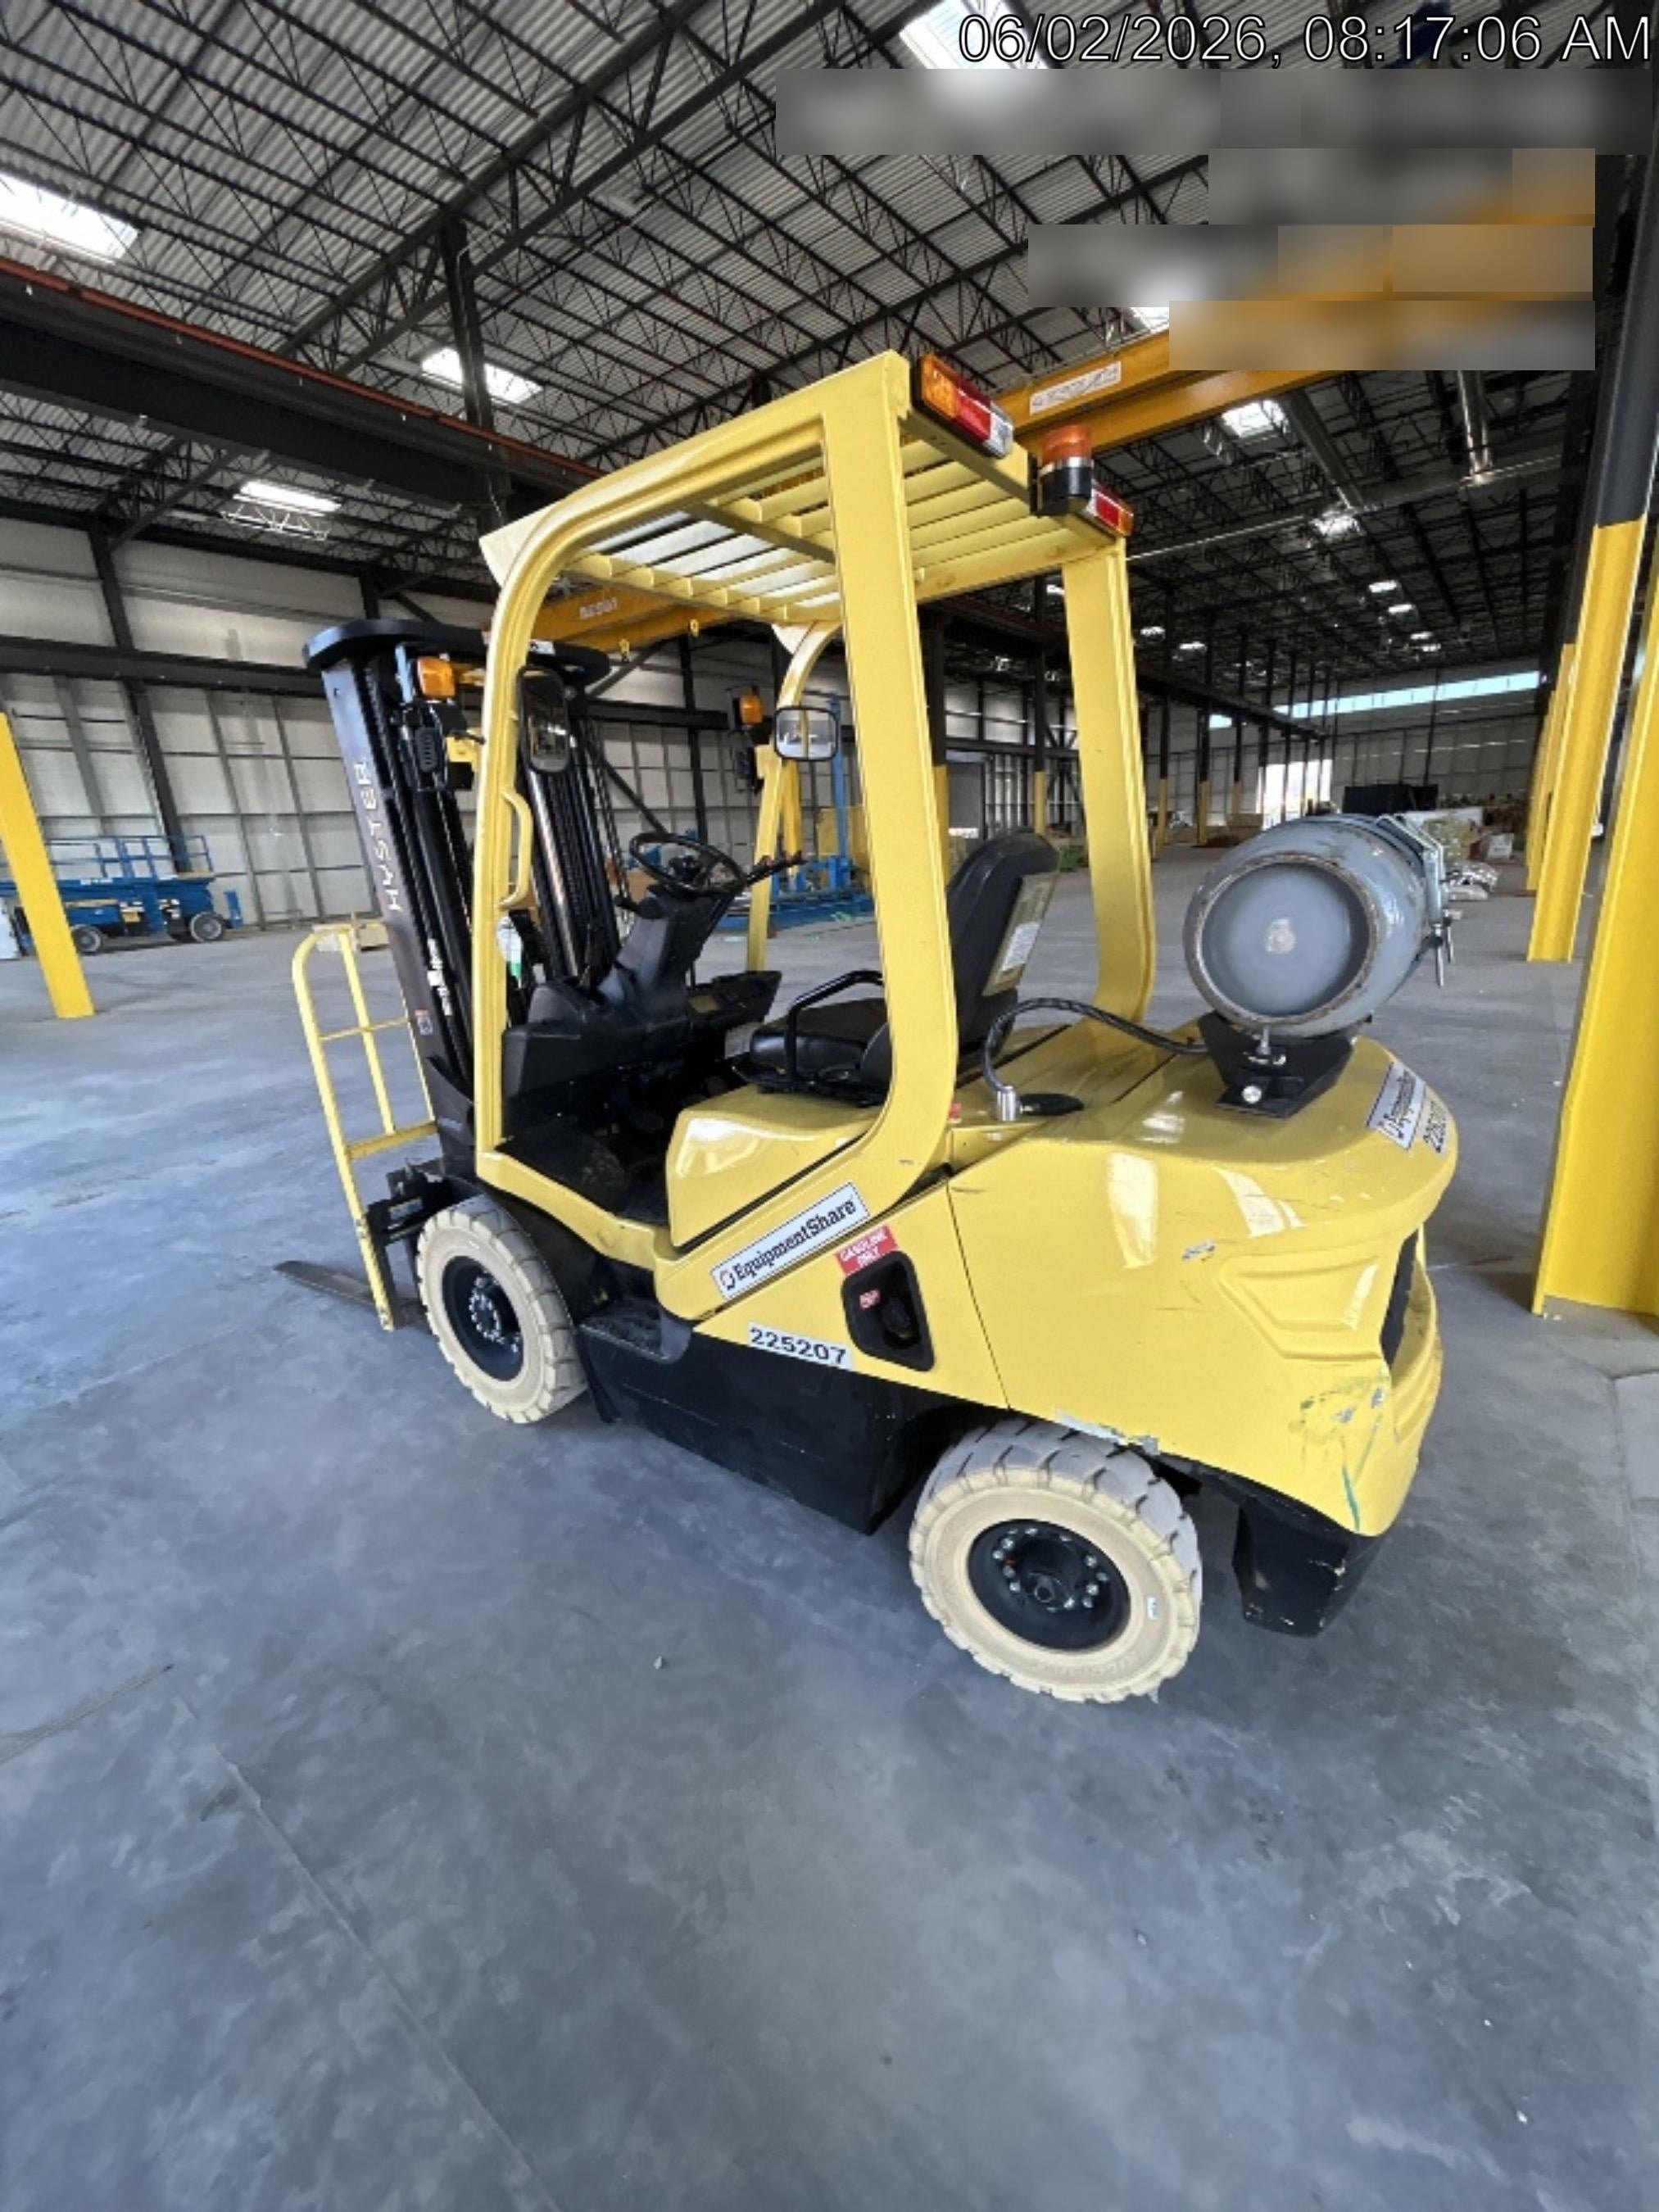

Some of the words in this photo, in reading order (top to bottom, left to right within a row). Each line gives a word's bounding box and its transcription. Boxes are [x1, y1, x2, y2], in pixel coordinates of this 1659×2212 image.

[353, 757, 401, 911] HYSTER
[734, 1199, 857, 1282] EquipmentShare
[749, 1326, 847, 1366] 225207
